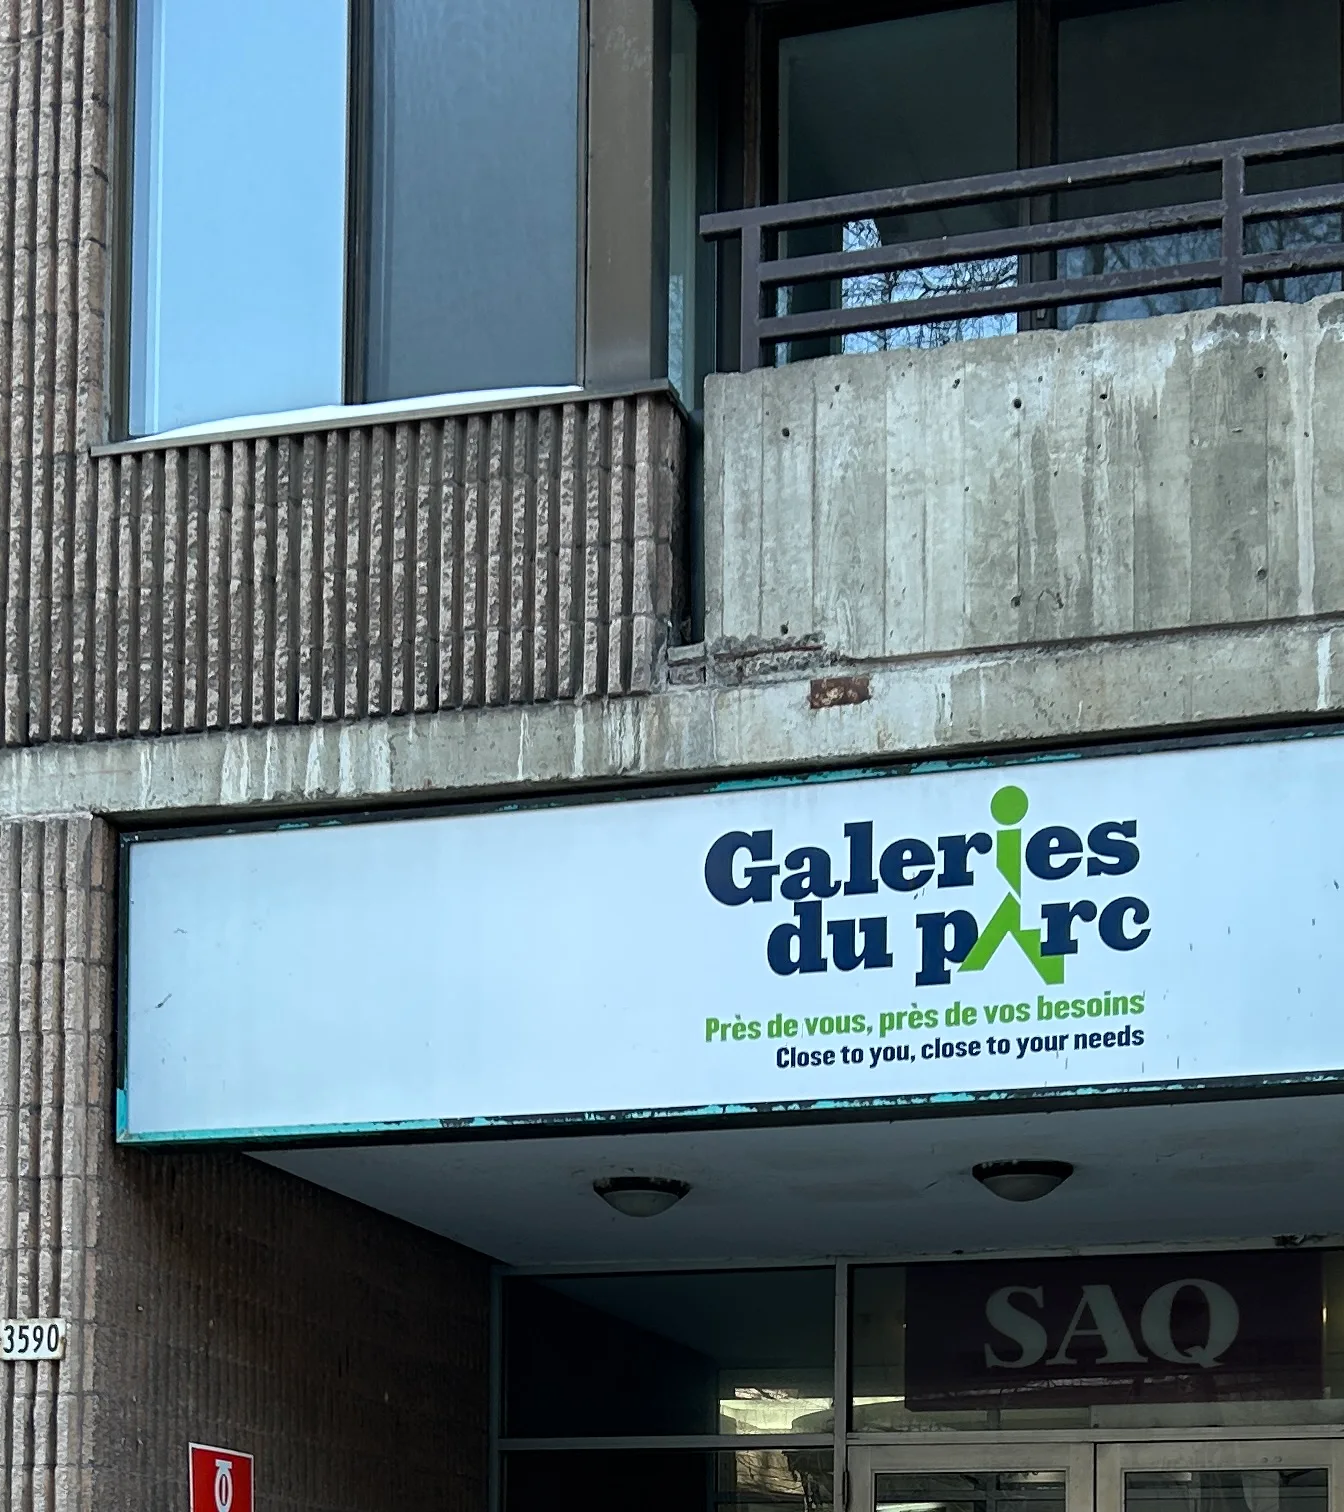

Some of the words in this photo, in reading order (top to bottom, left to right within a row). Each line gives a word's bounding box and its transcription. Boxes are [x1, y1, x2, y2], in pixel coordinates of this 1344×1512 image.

[704, 785, 1141, 906] Galeries
[767, 899, 894, 976] du
[915, 891, 1152, 987] parc
[705, 1014, 762, 1042] Près
[767, 1013, 799, 1038] de
[805, 1013, 873, 1036] vous,
[879, 1002, 939, 1038] près
[945, 1001, 978, 1027] de
[983, 1003, 1031, 1025] vos
[1037, 990, 1146, 1021] besoins
[776, 1046, 836, 1068] Close
[840, 1045, 864, 1064] to
[869, 1044, 916, 1069] you,
[921, 1037, 982, 1059] close
[986, 1036, 1011, 1055] to
[1016, 1033, 1069, 1059] your
[1074, 1025, 1145, 1050] needs
[3, 1323, 60, 1353] 3590
[984, 1278, 1241, 1369] SAQ
